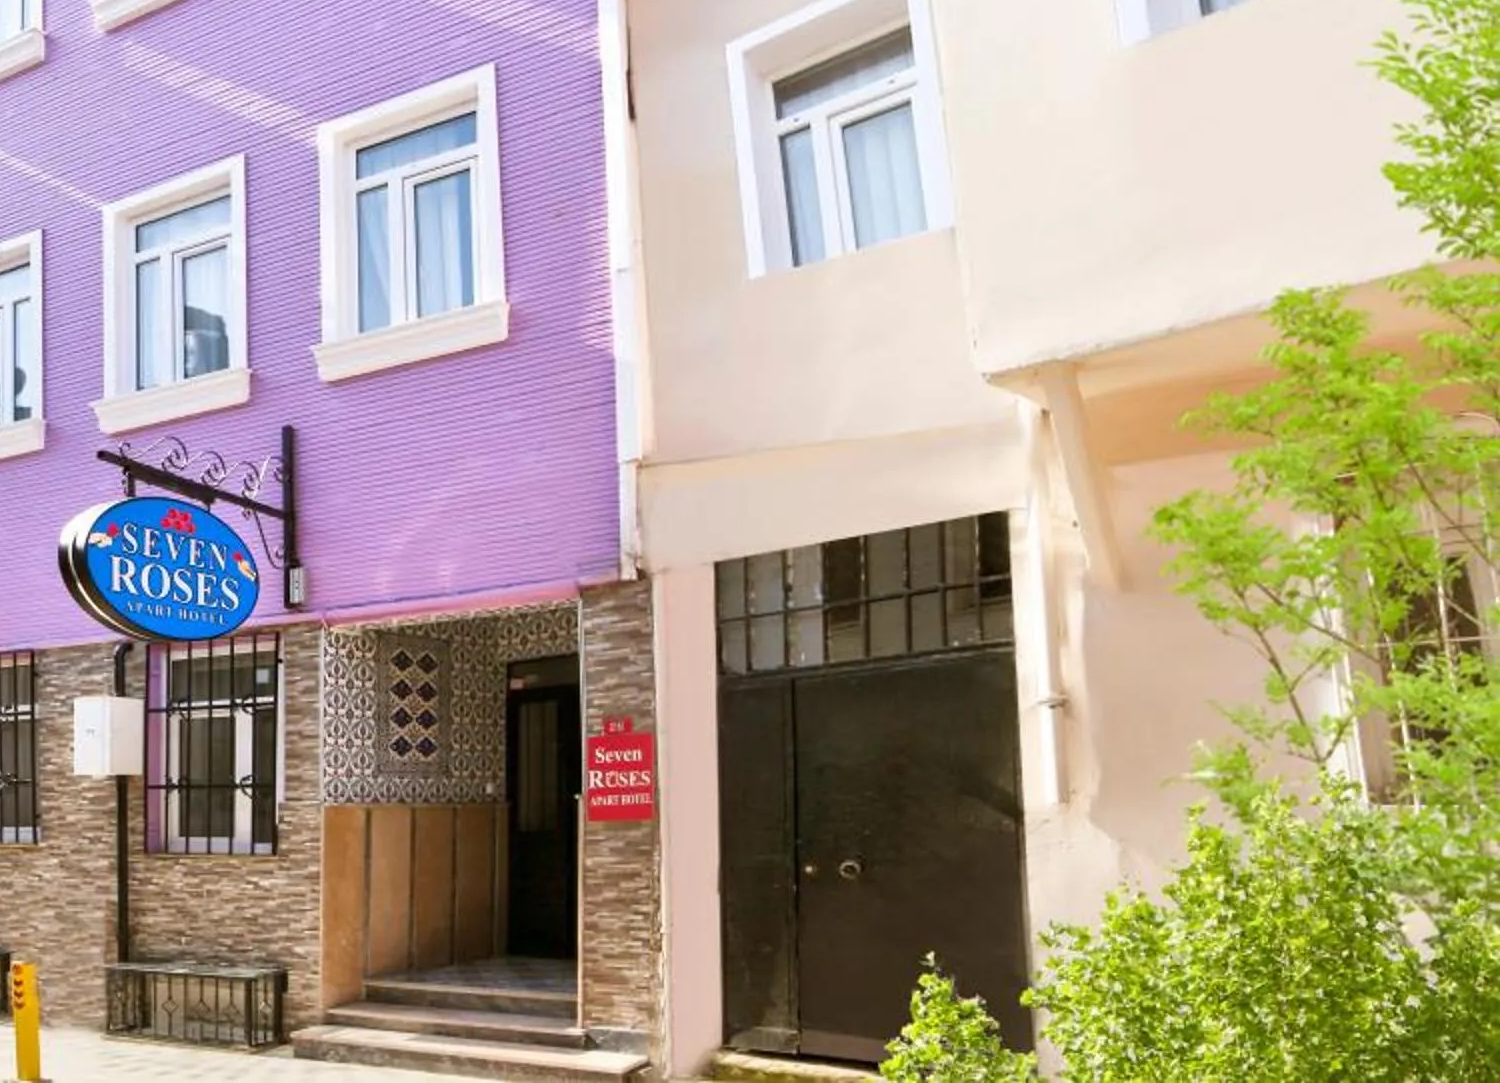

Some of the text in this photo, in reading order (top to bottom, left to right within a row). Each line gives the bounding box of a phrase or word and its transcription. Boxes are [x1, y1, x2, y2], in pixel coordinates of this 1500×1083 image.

[123, 523, 227, 570] SEVEN
[110, 555, 240, 611] ROSES
[127, 601, 227, 625] APART HOTEL
[595, 747, 642, 764] Seven
[588, 770, 651, 788] ROSES
